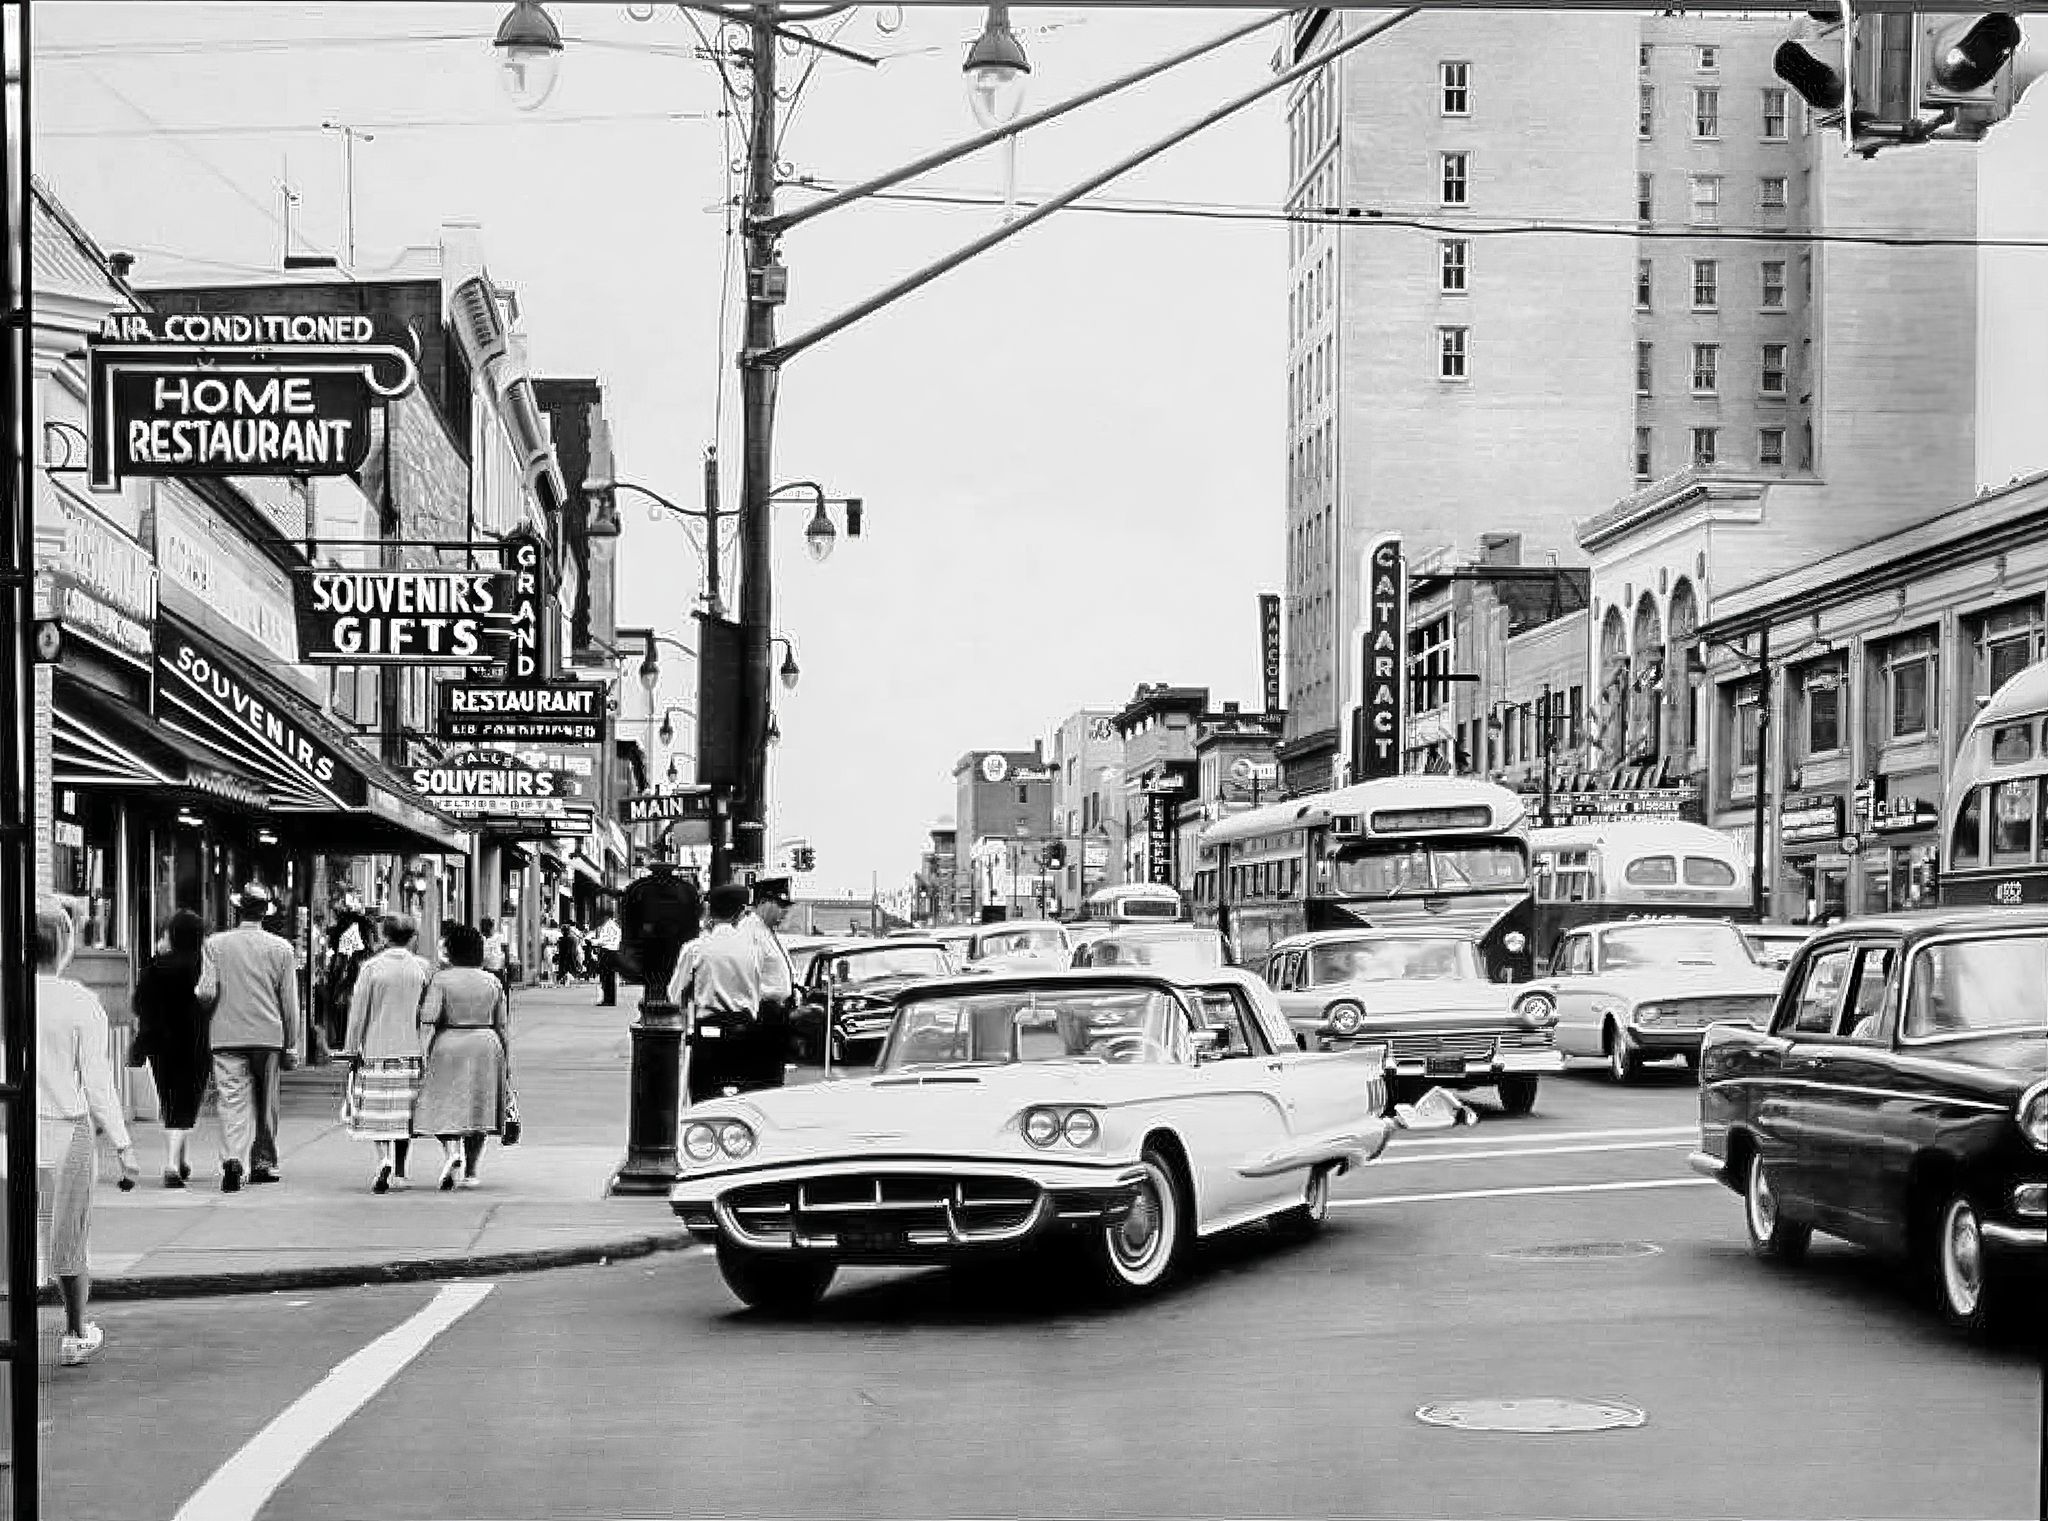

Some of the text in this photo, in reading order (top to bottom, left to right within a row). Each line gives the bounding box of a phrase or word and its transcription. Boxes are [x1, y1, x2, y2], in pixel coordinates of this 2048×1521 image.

[101, 315, 373, 342] AIR CONDITIONED
[154, 377, 316, 414] HOME
[129, 419, 352, 463] RESTAURANT
[312, 575, 494, 614] SOUVENIRS
[515, 545, 536, 677] GRAND
[333, 617, 479, 656] GIFTS
[1373, 546, 1395, 759] CATARACT
[177, 646, 334, 780] SOUVENIRS
[452, 689, 594, 713] RESTAURANT
[413, 770, 555, 796] SOUVENIRS
[630, 797, 684, 819] MAIN
